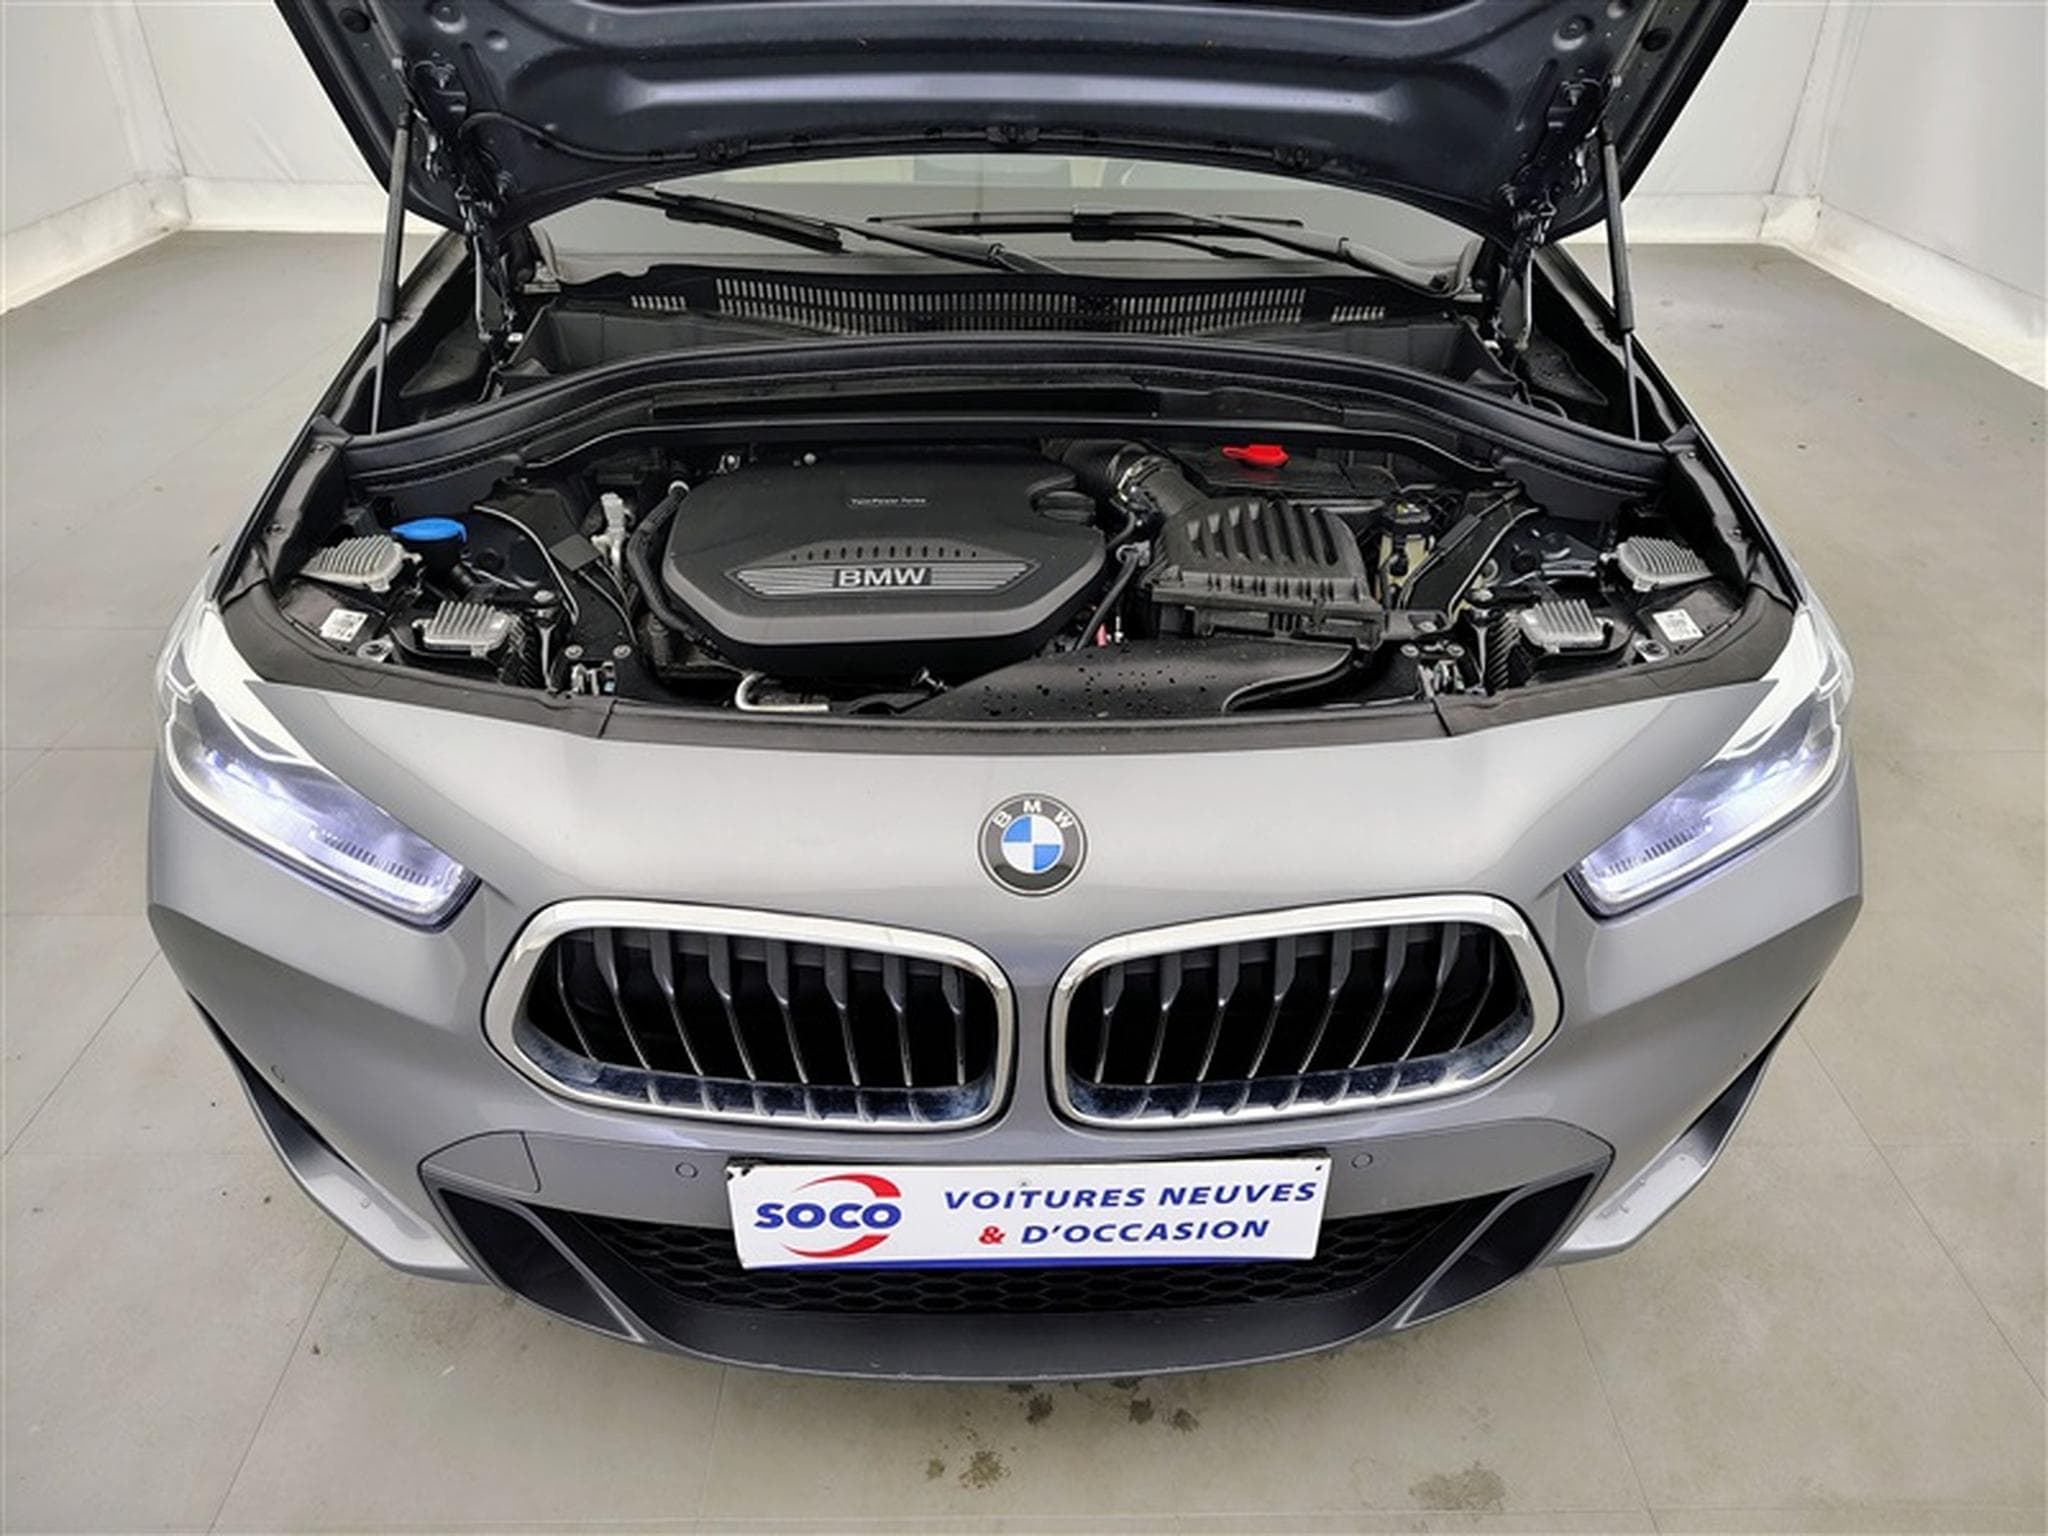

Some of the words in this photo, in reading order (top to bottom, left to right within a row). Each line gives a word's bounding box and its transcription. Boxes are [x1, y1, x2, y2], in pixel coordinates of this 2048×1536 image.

[839, 567, 926, 587] BMW
[992, 800, 1073, 828] BMW
[944, 1189, 1145, 1210] VOITURES
[1159, 1182, 1317, 1206] NEUVES
[754, 1203, 902, 1229] SOCO
[978, 1226, 1006, 1245] &
